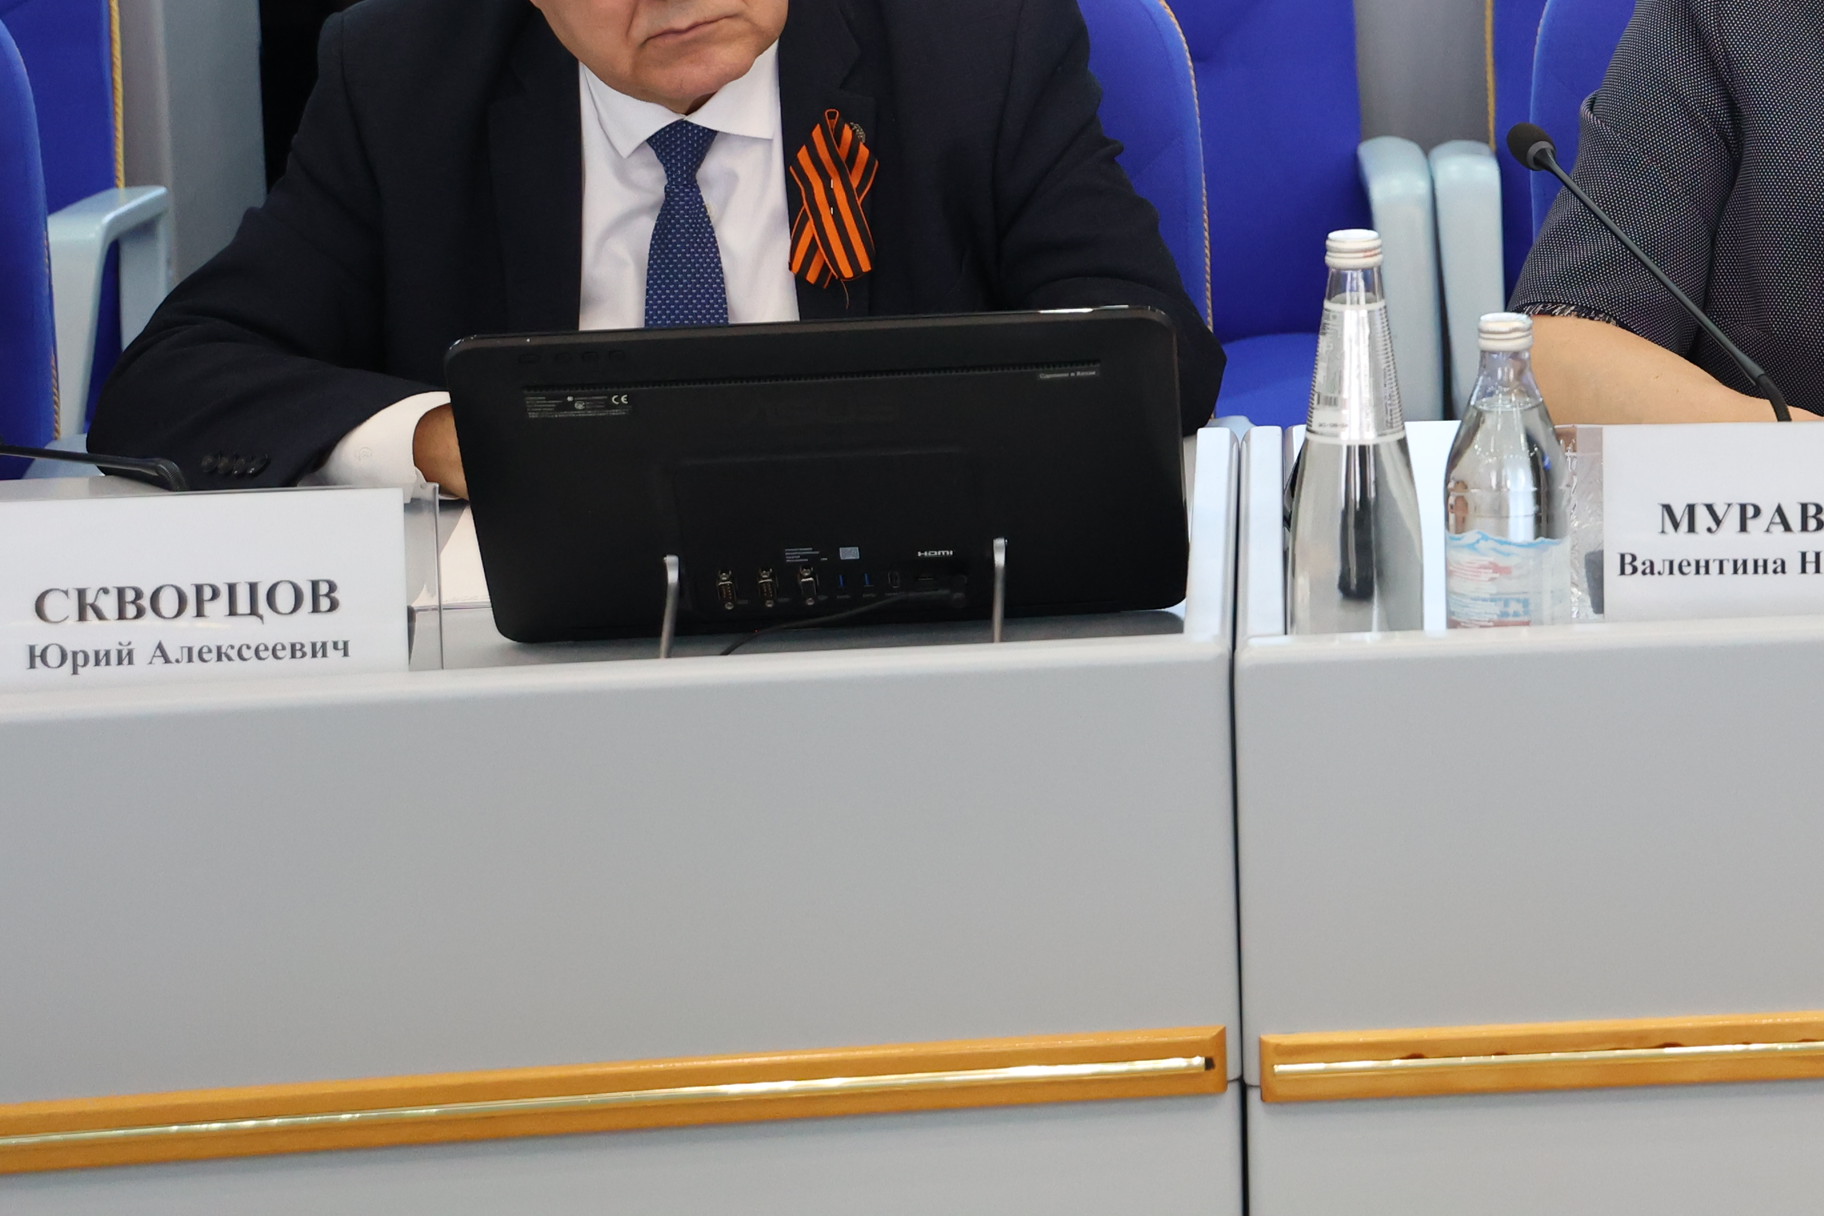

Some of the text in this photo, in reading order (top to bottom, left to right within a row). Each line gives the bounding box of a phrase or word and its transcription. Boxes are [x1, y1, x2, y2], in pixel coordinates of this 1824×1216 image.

[917, 549, 954, 557] HDMI
[1617, 551, 1788, 577] Валентина
[33, 578, 341, 624] СКВОРЦОВ
[26, 639, 352, 676] Юрий Алексеевич
